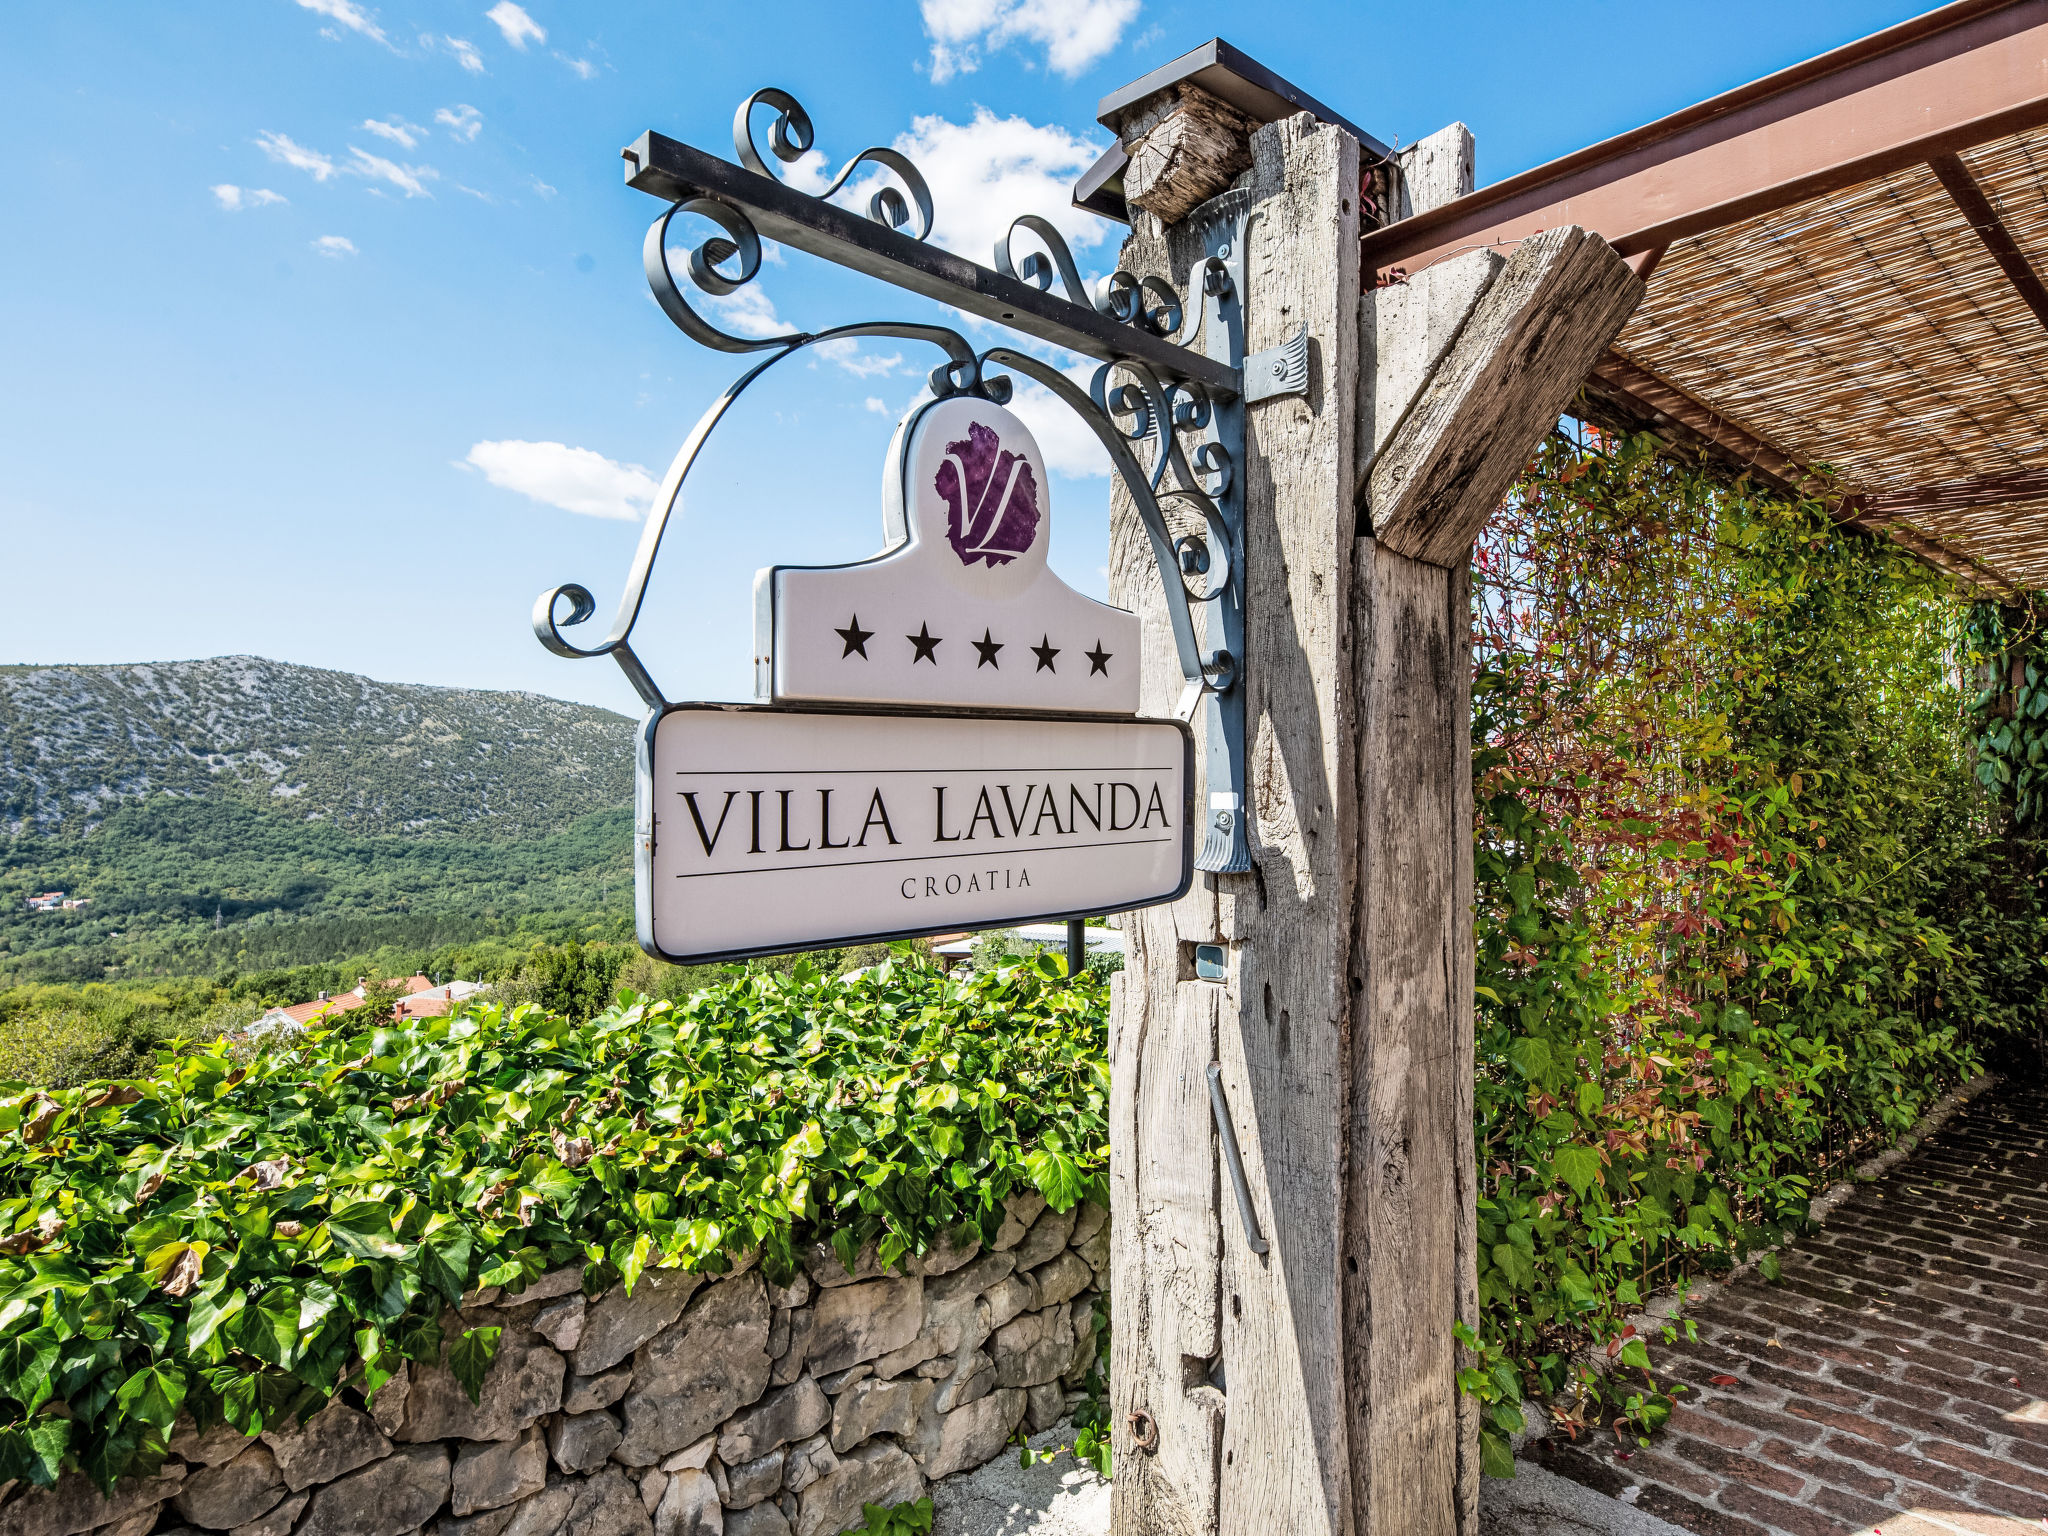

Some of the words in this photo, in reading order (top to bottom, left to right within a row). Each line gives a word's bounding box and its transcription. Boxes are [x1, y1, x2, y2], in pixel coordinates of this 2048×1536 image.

[676, 786, 901, 857] VILLA
[933, 781, 1171, 842] LAVANDA
[900, 868, 1031, 899] CROATIA
